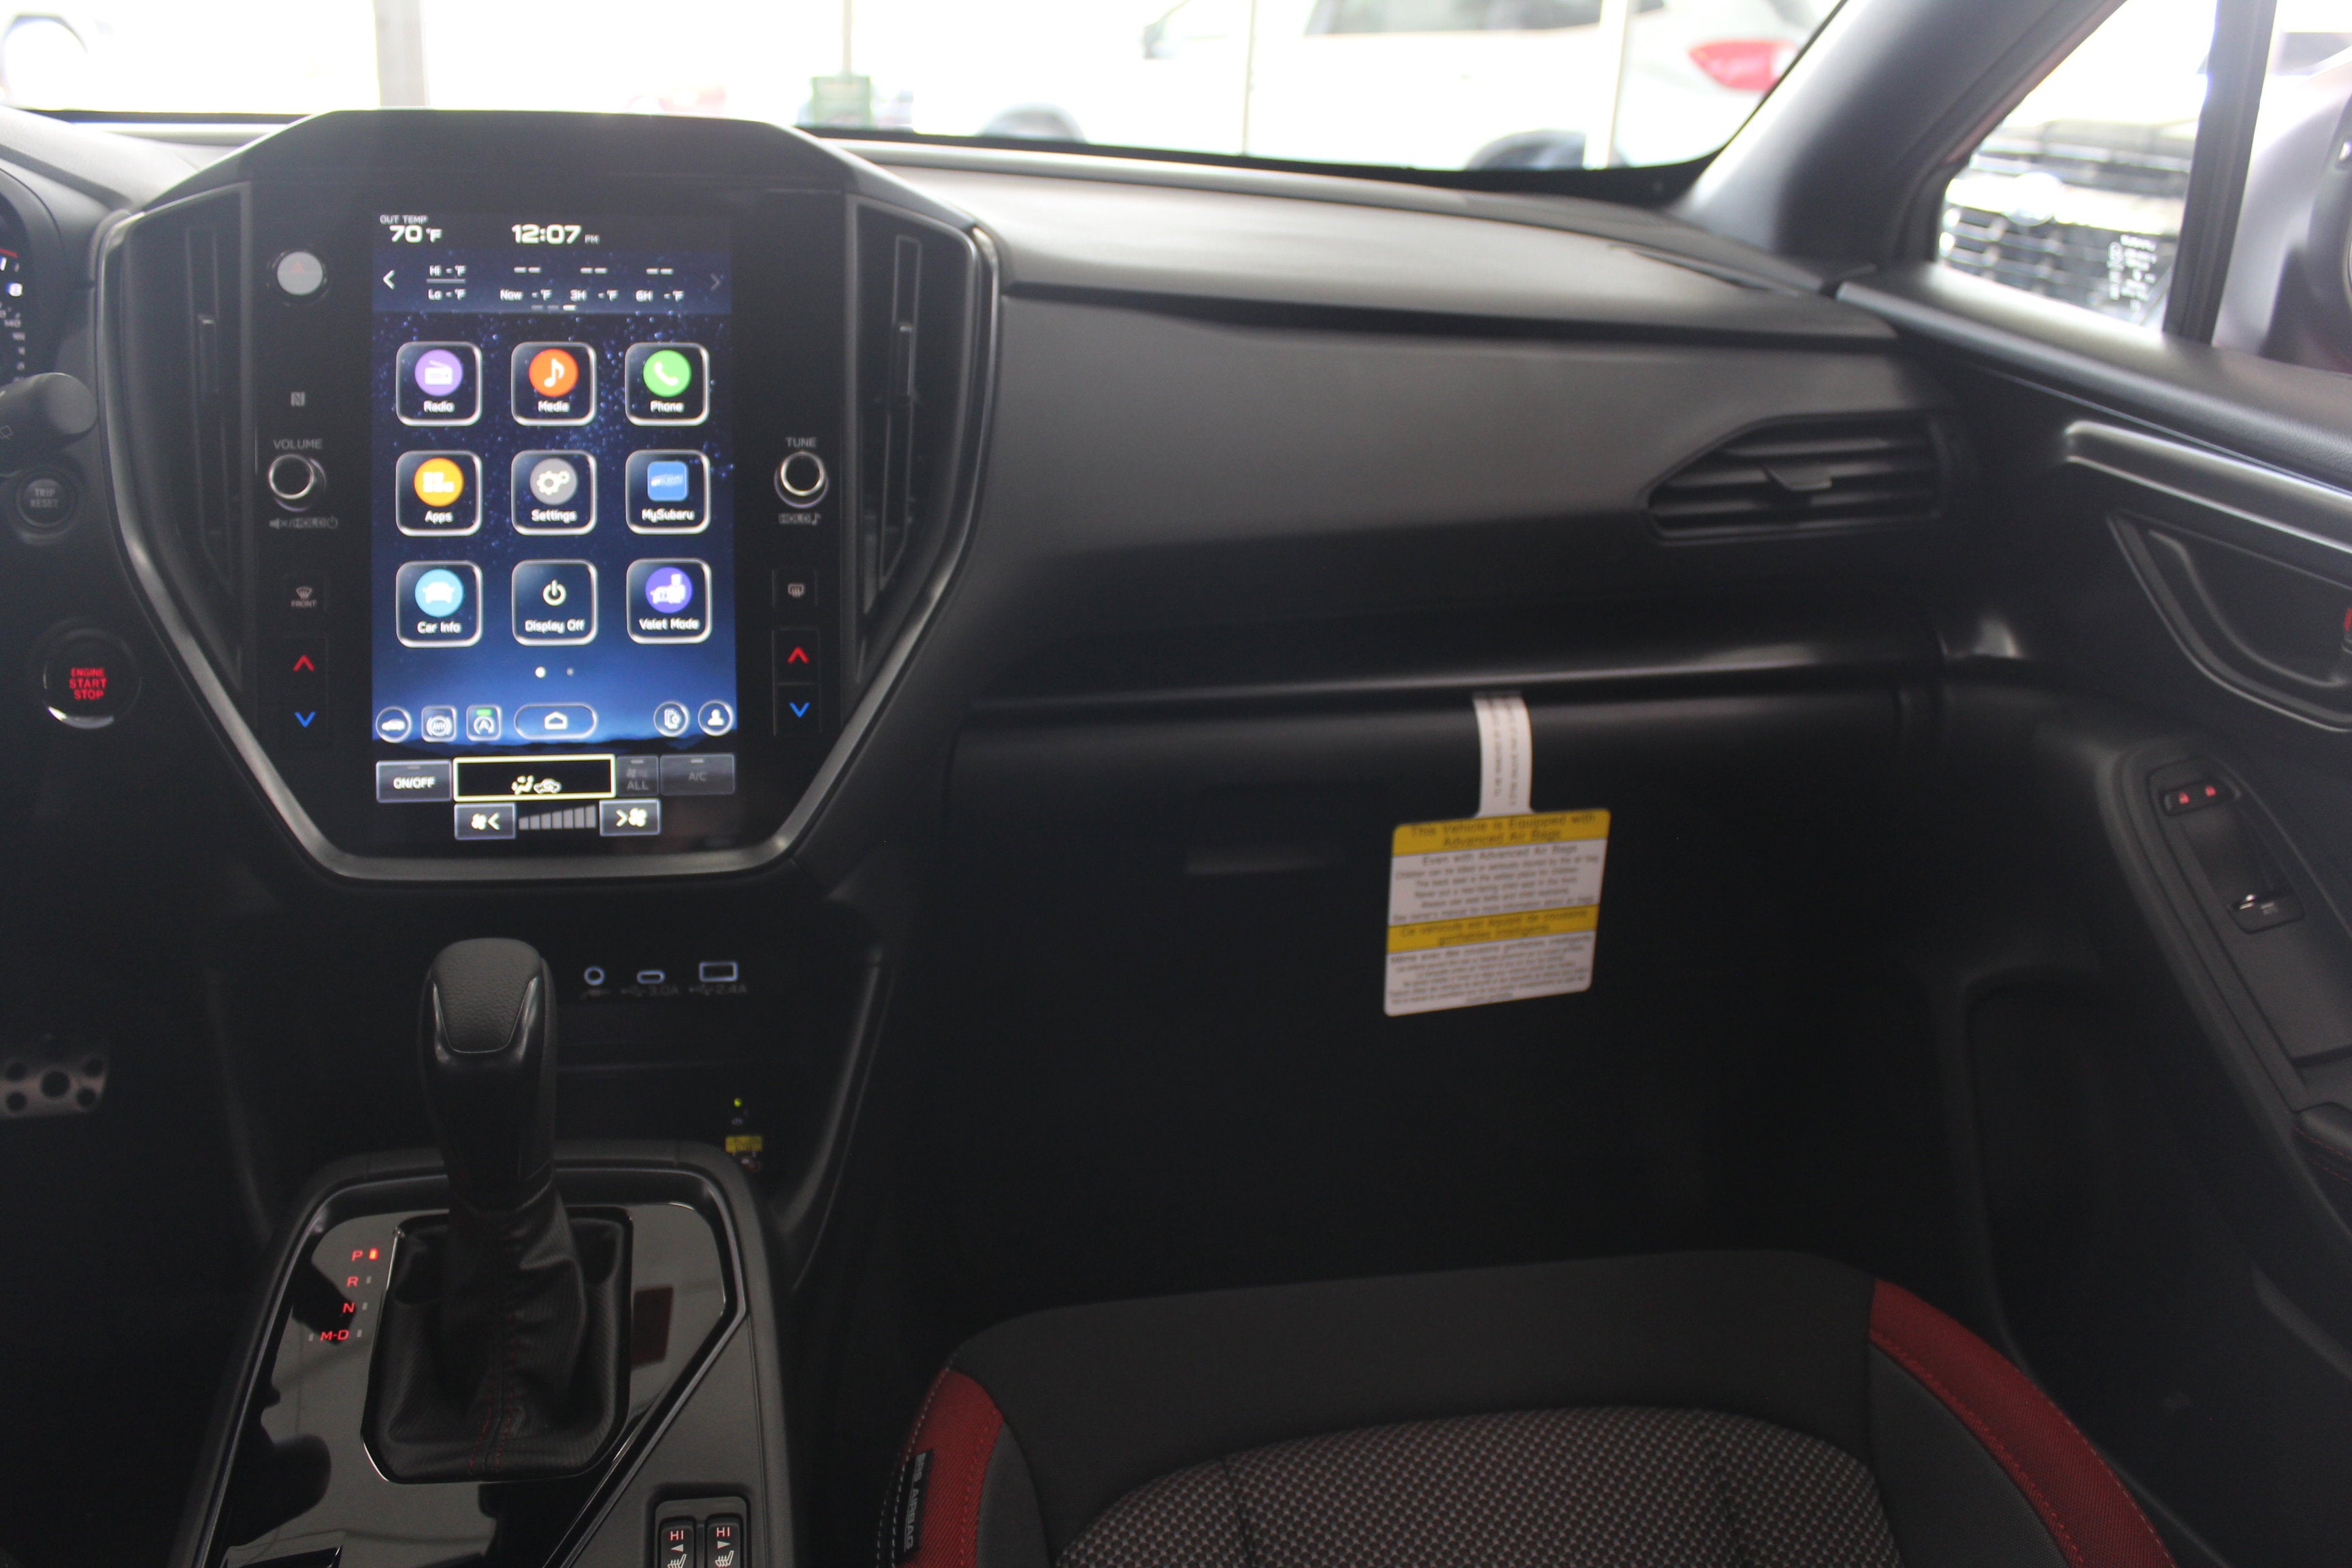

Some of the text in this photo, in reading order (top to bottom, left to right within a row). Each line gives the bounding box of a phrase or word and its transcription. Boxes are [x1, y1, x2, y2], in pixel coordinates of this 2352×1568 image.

[380, 214, 428, 224] OUT TEMP
[389, 225, 423, 242] 70
[512, 224, 600, 244] 12:07 PM
[428, 289, 442, 301] Lo
[500, 290, 523, 301] Now
[570, 290, 587, 301] 3H
[423, 401, 455, 413] Radio
[538, 401, 570, 413] Media
[650, 401, 685, 413] Phone
[273, 439, 323, 450] VOLUME
[785, 437, 817, 448] TUNE
[35, 488, 55, 497] TRIP
[425, 510, 453, 524] Apps
[531, 509, 577, 523] Settings
[642, 509, 694, 523] MySubaru
[291, 600, 317, 608] FRONT
[417, 621, 462, 634] Car Info
[525, 619, 585, 634] Display Off
[638, 618, 700, 630] Valet Mode
[71, 668, 105, 677] ENGINE
[69, 678, 108, 689] START
[74, 689, 104, 700] STOP
[688, 772, 708, 782] A/C
[393, 777, 436, 789] ON/OFF
[626, 781, 649, 791] ALL
[351, 1250, 363, 1262] P
[346, 1276, 359, 1287] R
[342, 1302, 356, 1313] N
[906, 1488, 919, 1550] AIRBAG
[670, 1530, 684, 1541] HI
[716, 1526, 730, 1537] HI
